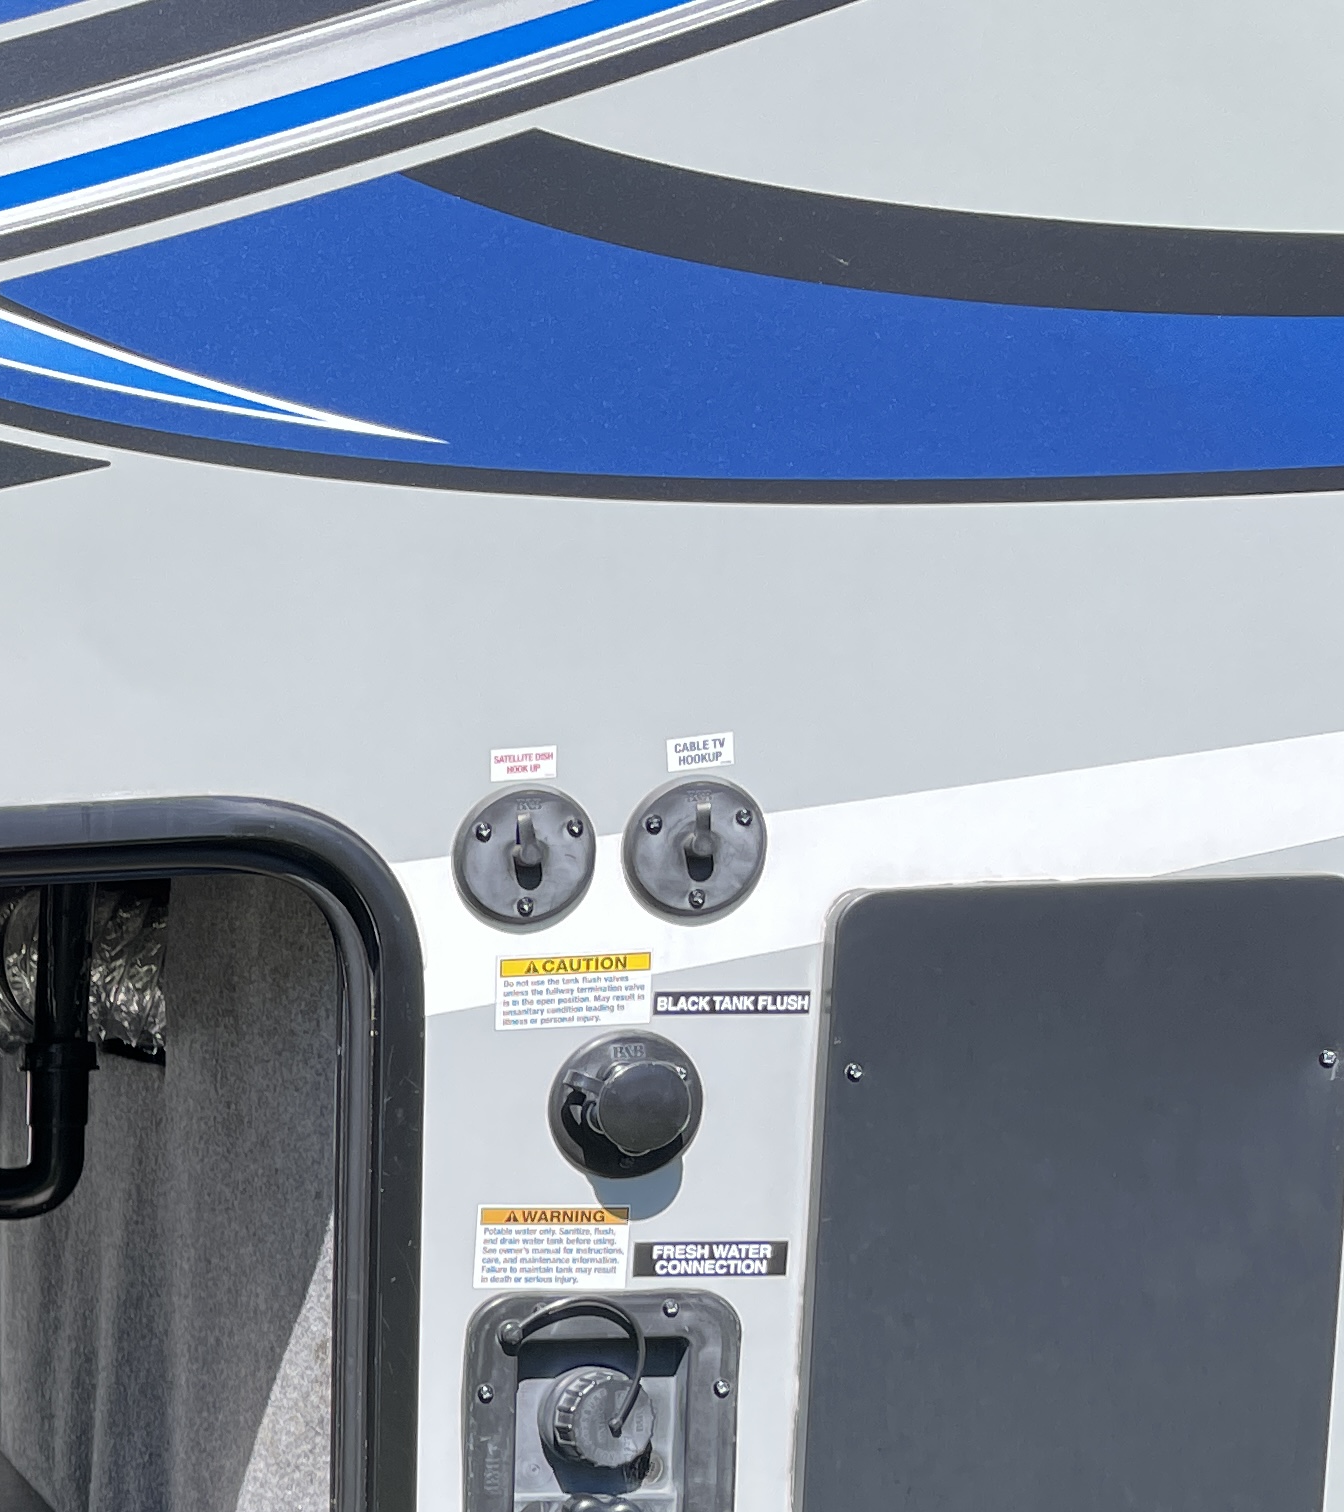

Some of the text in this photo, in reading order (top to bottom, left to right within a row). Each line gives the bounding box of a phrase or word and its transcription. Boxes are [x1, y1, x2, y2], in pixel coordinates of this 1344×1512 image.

[674, 737, 725, 753] CABLE TV
[493, 752, 554, 764] SATELLITE DISH
[678, 751, 722, 766] HOOKUP
[529, 763, 541, 773] UP
[541, 957, 627, 973] CAUTION
[577, 983, 622, 993] termination
[624, 983, 645, 991] valve
[522, 998, 534, 1006] the
[536, 998, 555, 1006] open
[558, 996, 591, 1005] position.
[593, 994, 610, 1003] May
[612, 993, 635, 1001] result
[656, 995, 809, 1011] BLACK TANK FLUSH
[503, 1008, 544, 1016] unsanitary
[586, 1004, 614, 1013] leading
[540, 1015, 574, 1025] personal
[577, 1015, 601, 1023] injury.
[521, 1210, 605, 1223] WARNING
[483, 1227, 512, 1236] Potable
[559, 1227, 592, 1236] Sanitize,
[594, 1227, 616, 1236] flush,
[500, 1237, 520, 1245] drain
[547, 1237, 564, 1245] tank
[566, 1237, 591, 1245] before
[593, 1238, 617, 1247] using.
[482, 1247, 497, 1255] See
[499, 1247, 530, 1255] owner's
[575, 1247, 625, 1256] instructions,
[652, 1244, 772, 1260] FRESH WATER
[481, 1256, 619, 1265] care, and maintenance information.
[655, 1259, 768, 1274] CONNECTION
[481, 1266, 617, 1275] Failure to maintain tank may result
[490, 1275, 512, 1283] death
[524, 1275, 552, 1283] serious
[554, 1276, 579, 1285] injury.
